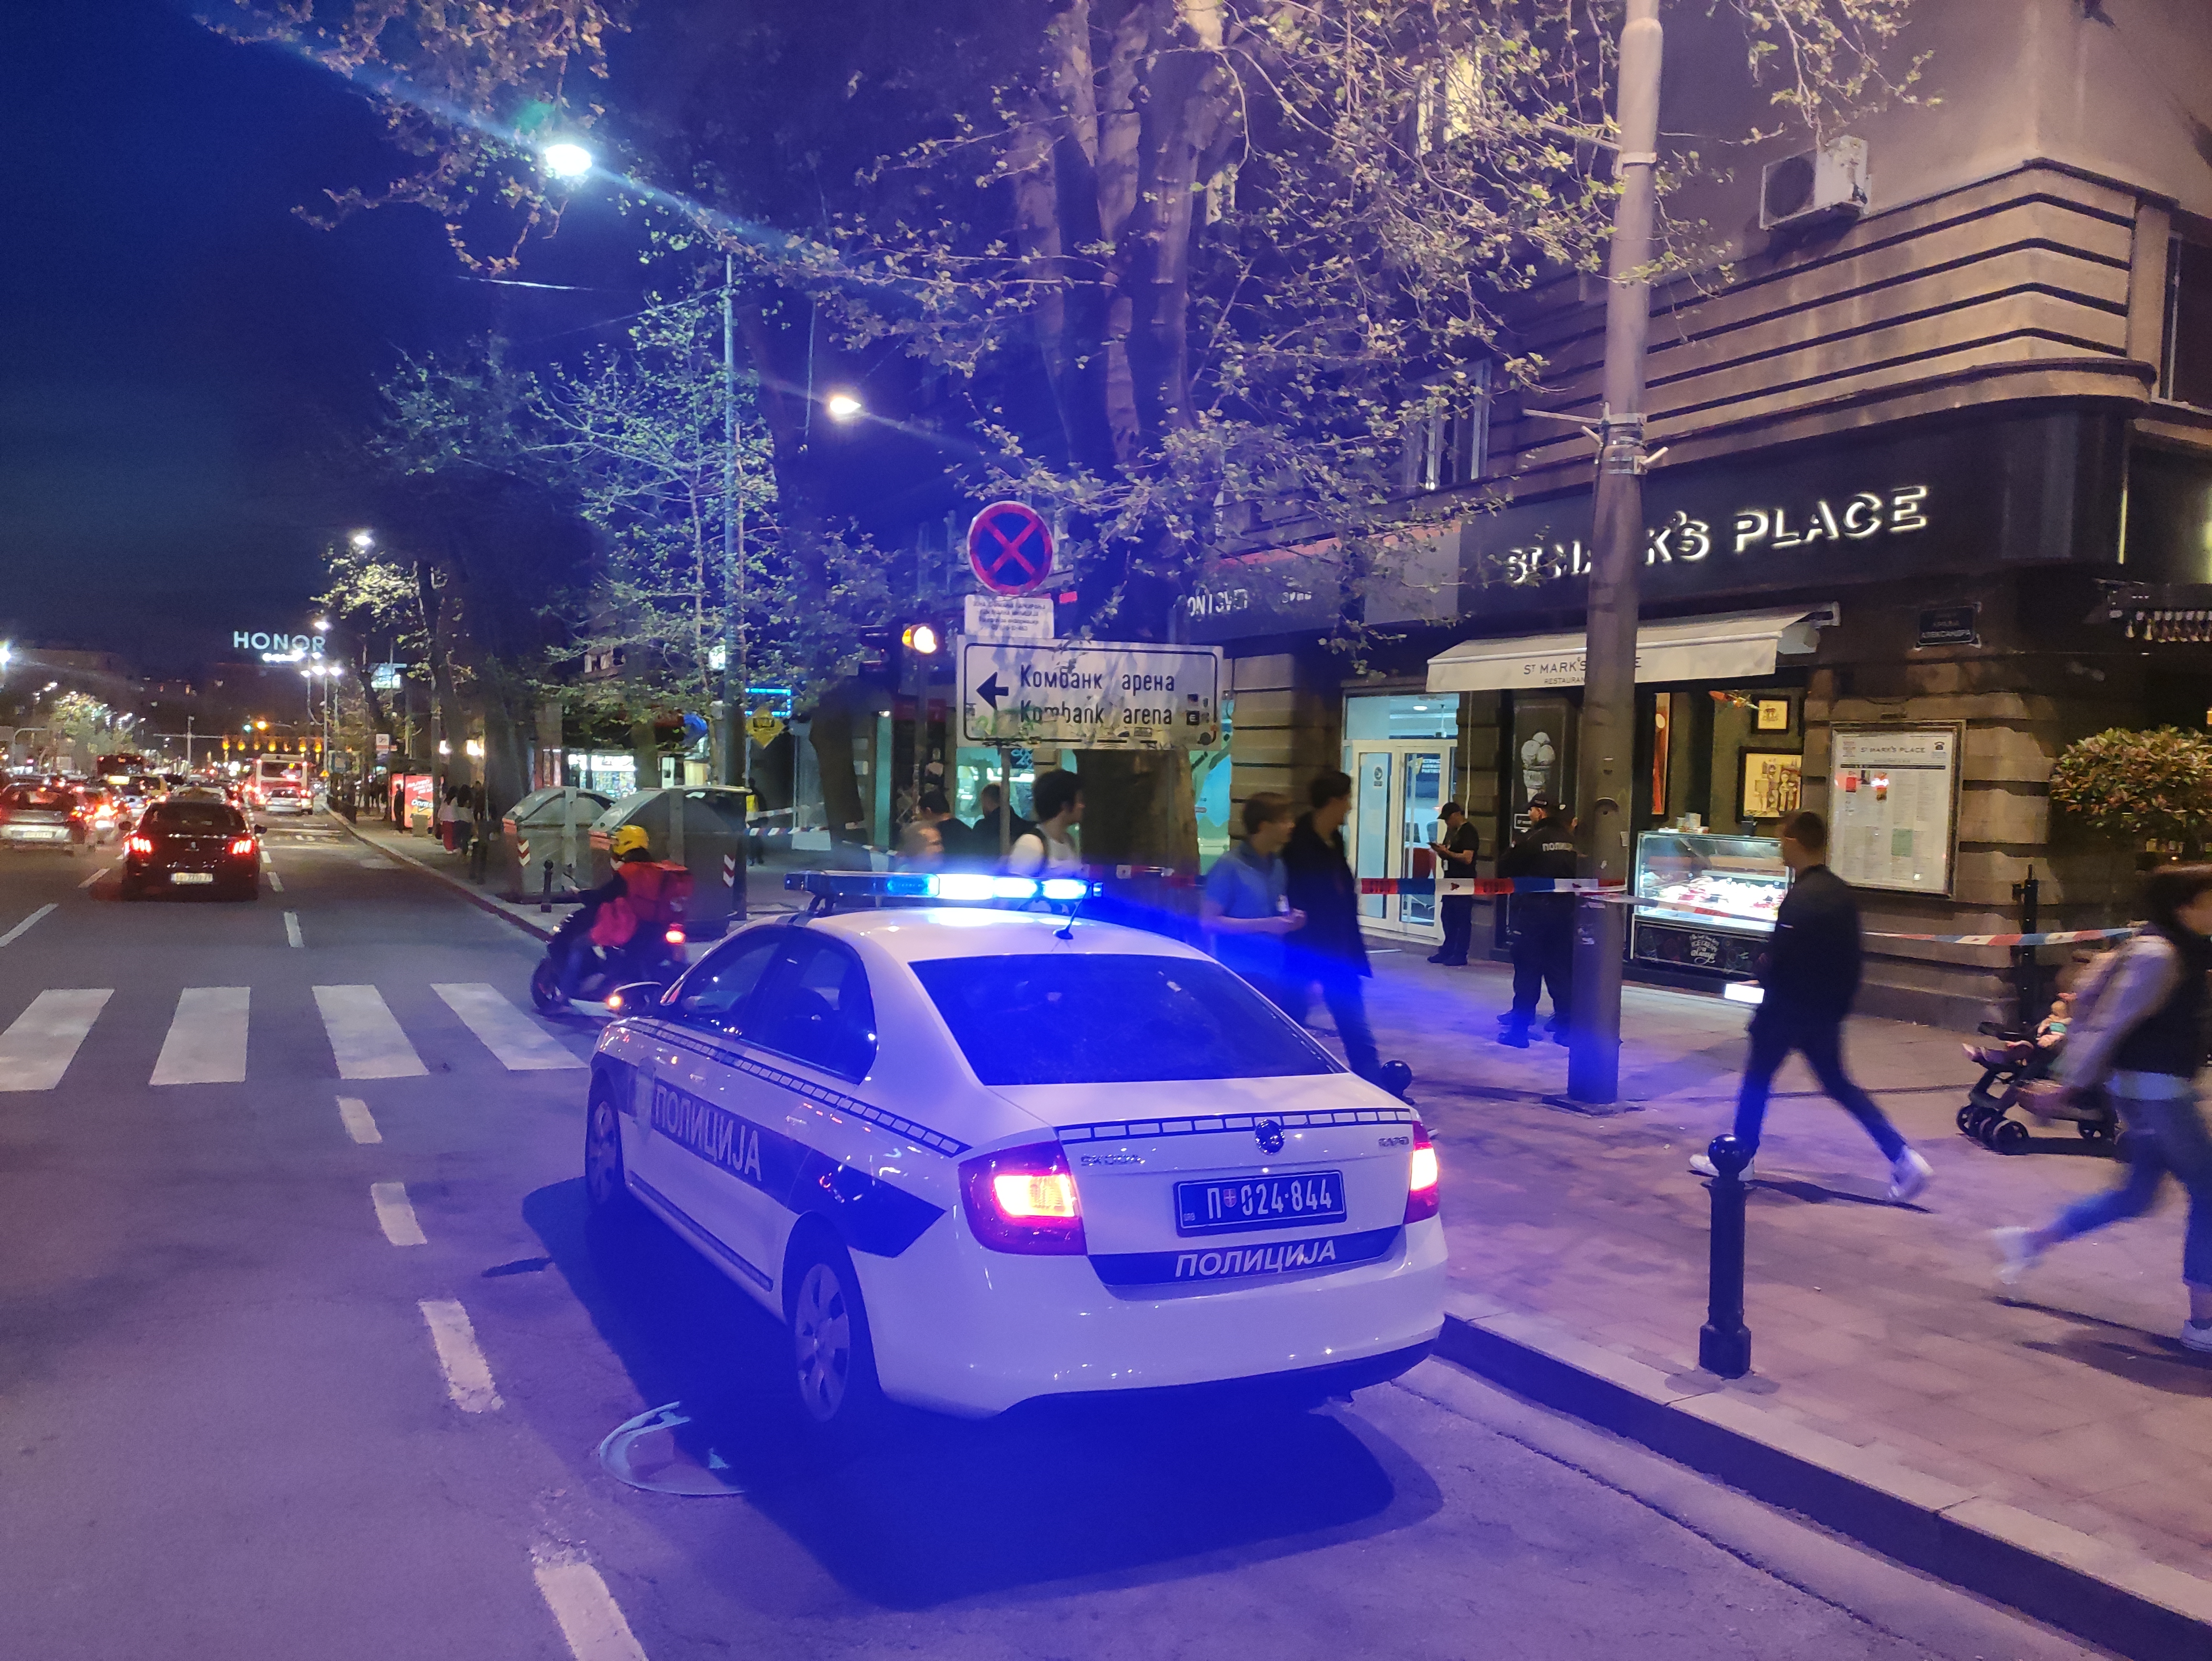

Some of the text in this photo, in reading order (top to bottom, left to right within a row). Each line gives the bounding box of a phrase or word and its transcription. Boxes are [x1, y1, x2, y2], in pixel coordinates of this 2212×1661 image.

[1553, 510, 1710, 577] MK'S
[1735, 485, 1927, 553] PLACE
[233, 631, 326, 651] HONOR
[1020, 664, 1174, 696] Комбанк арена
[1544, 676, 1585, 685] RESTAURAN
[1123, 706, 1173, 725] arena
[655, 1084, 762, 1182] ПОЛИЦИЈА
[1175, 1239, 1337, 1277] ПОЛИЦИЈА
